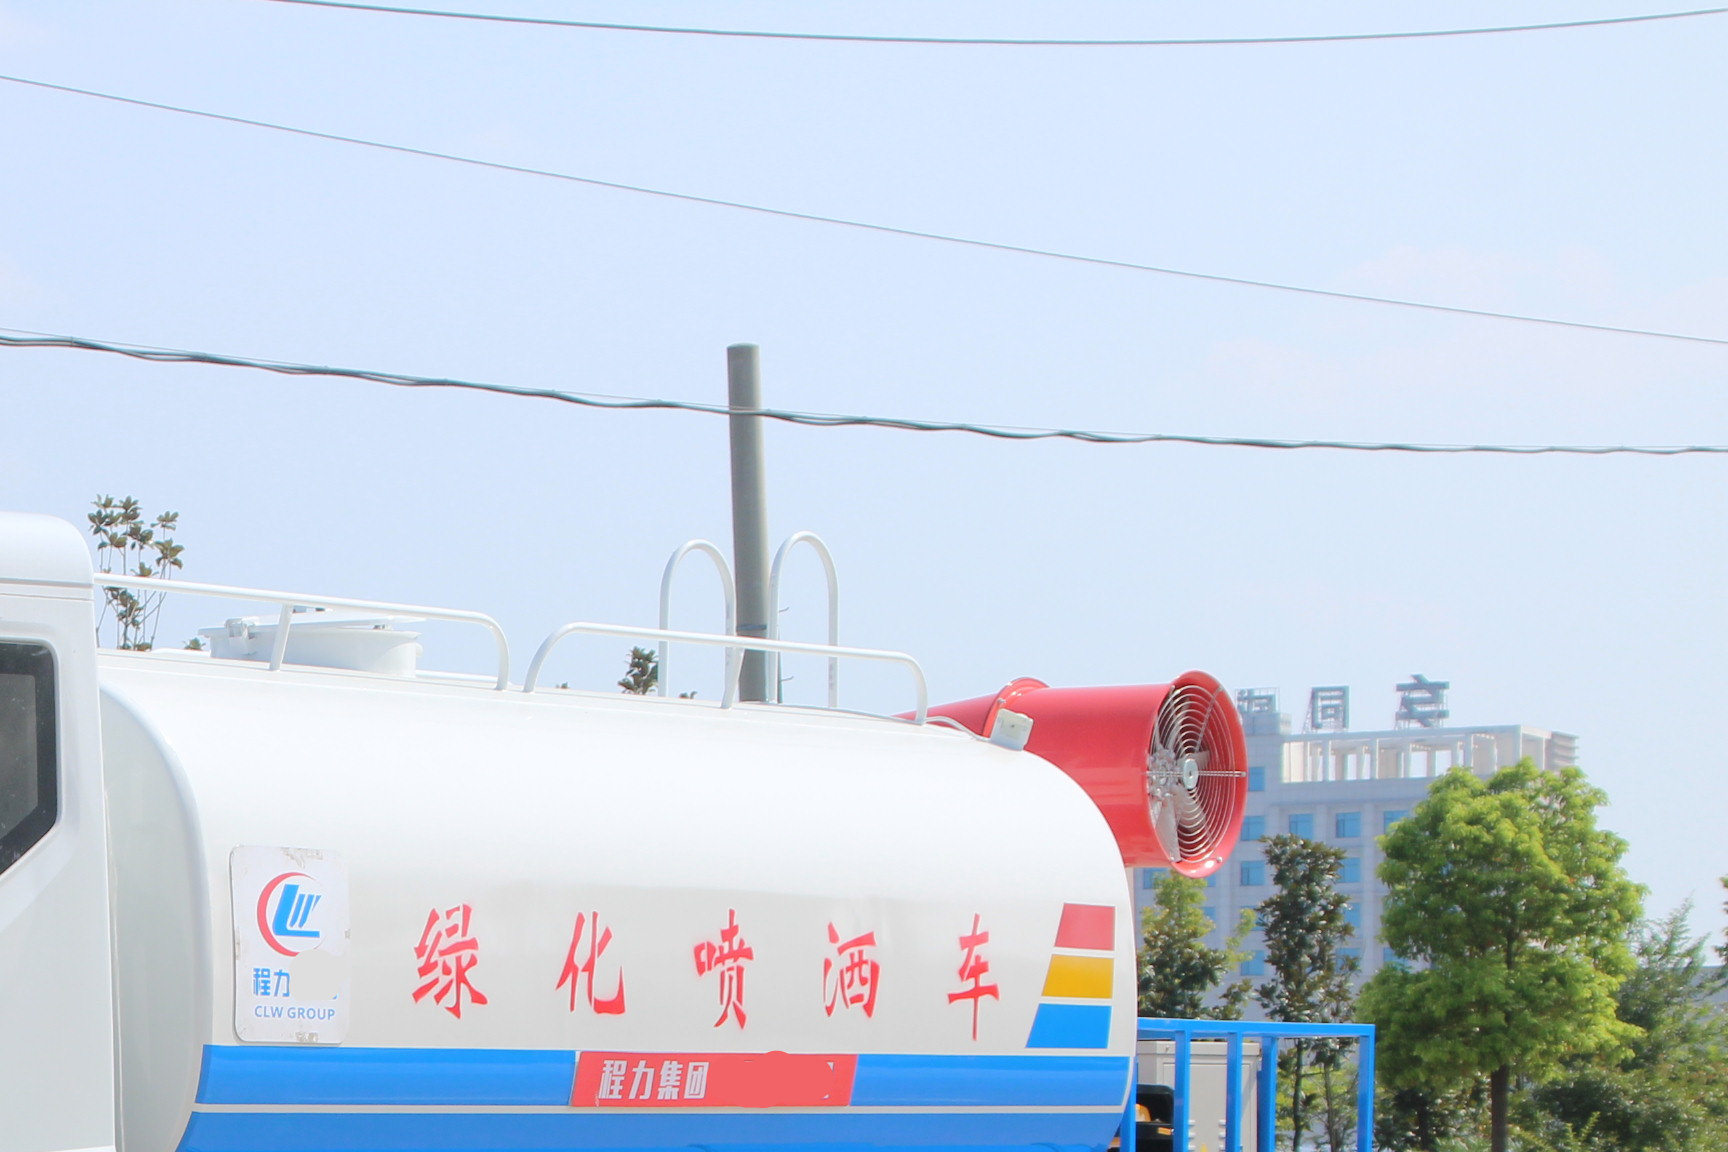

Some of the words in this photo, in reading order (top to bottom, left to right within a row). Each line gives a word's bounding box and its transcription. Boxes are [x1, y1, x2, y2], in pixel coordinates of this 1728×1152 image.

[253, 967, 291, 997] 程力
[412, 903, 1001, 1040] 绿化喷洒车
[255, 1005, 284, 1018] CLW
[287, 1006, 336, 1021] GROUP
[598, 1060, 709, 1100] 程力集团
